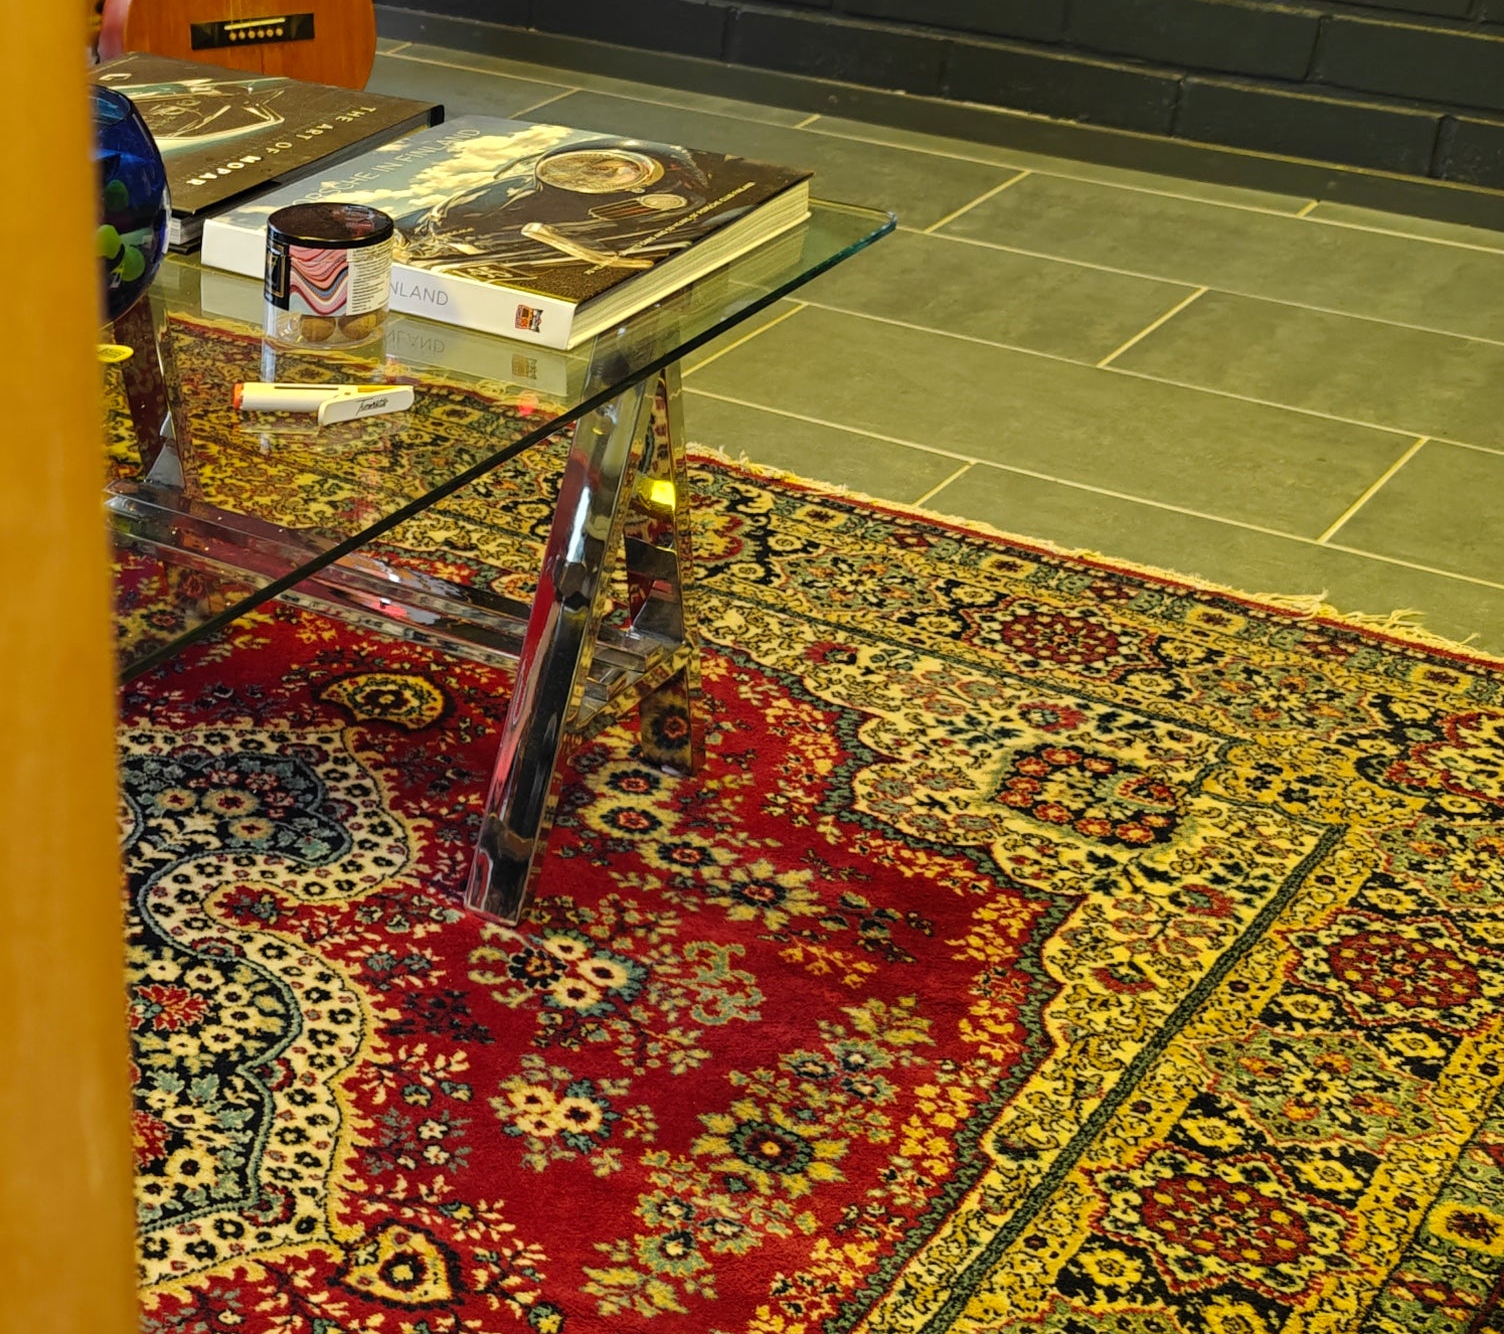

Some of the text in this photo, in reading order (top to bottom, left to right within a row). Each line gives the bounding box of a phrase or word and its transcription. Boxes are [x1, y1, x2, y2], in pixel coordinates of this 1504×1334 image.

[186, 106, 377, 186] THE ART OF MOPAR
[292, 128, 481, 205] ORSCHE IN FINLAND
[389, 281, 449, 306] NLAND
